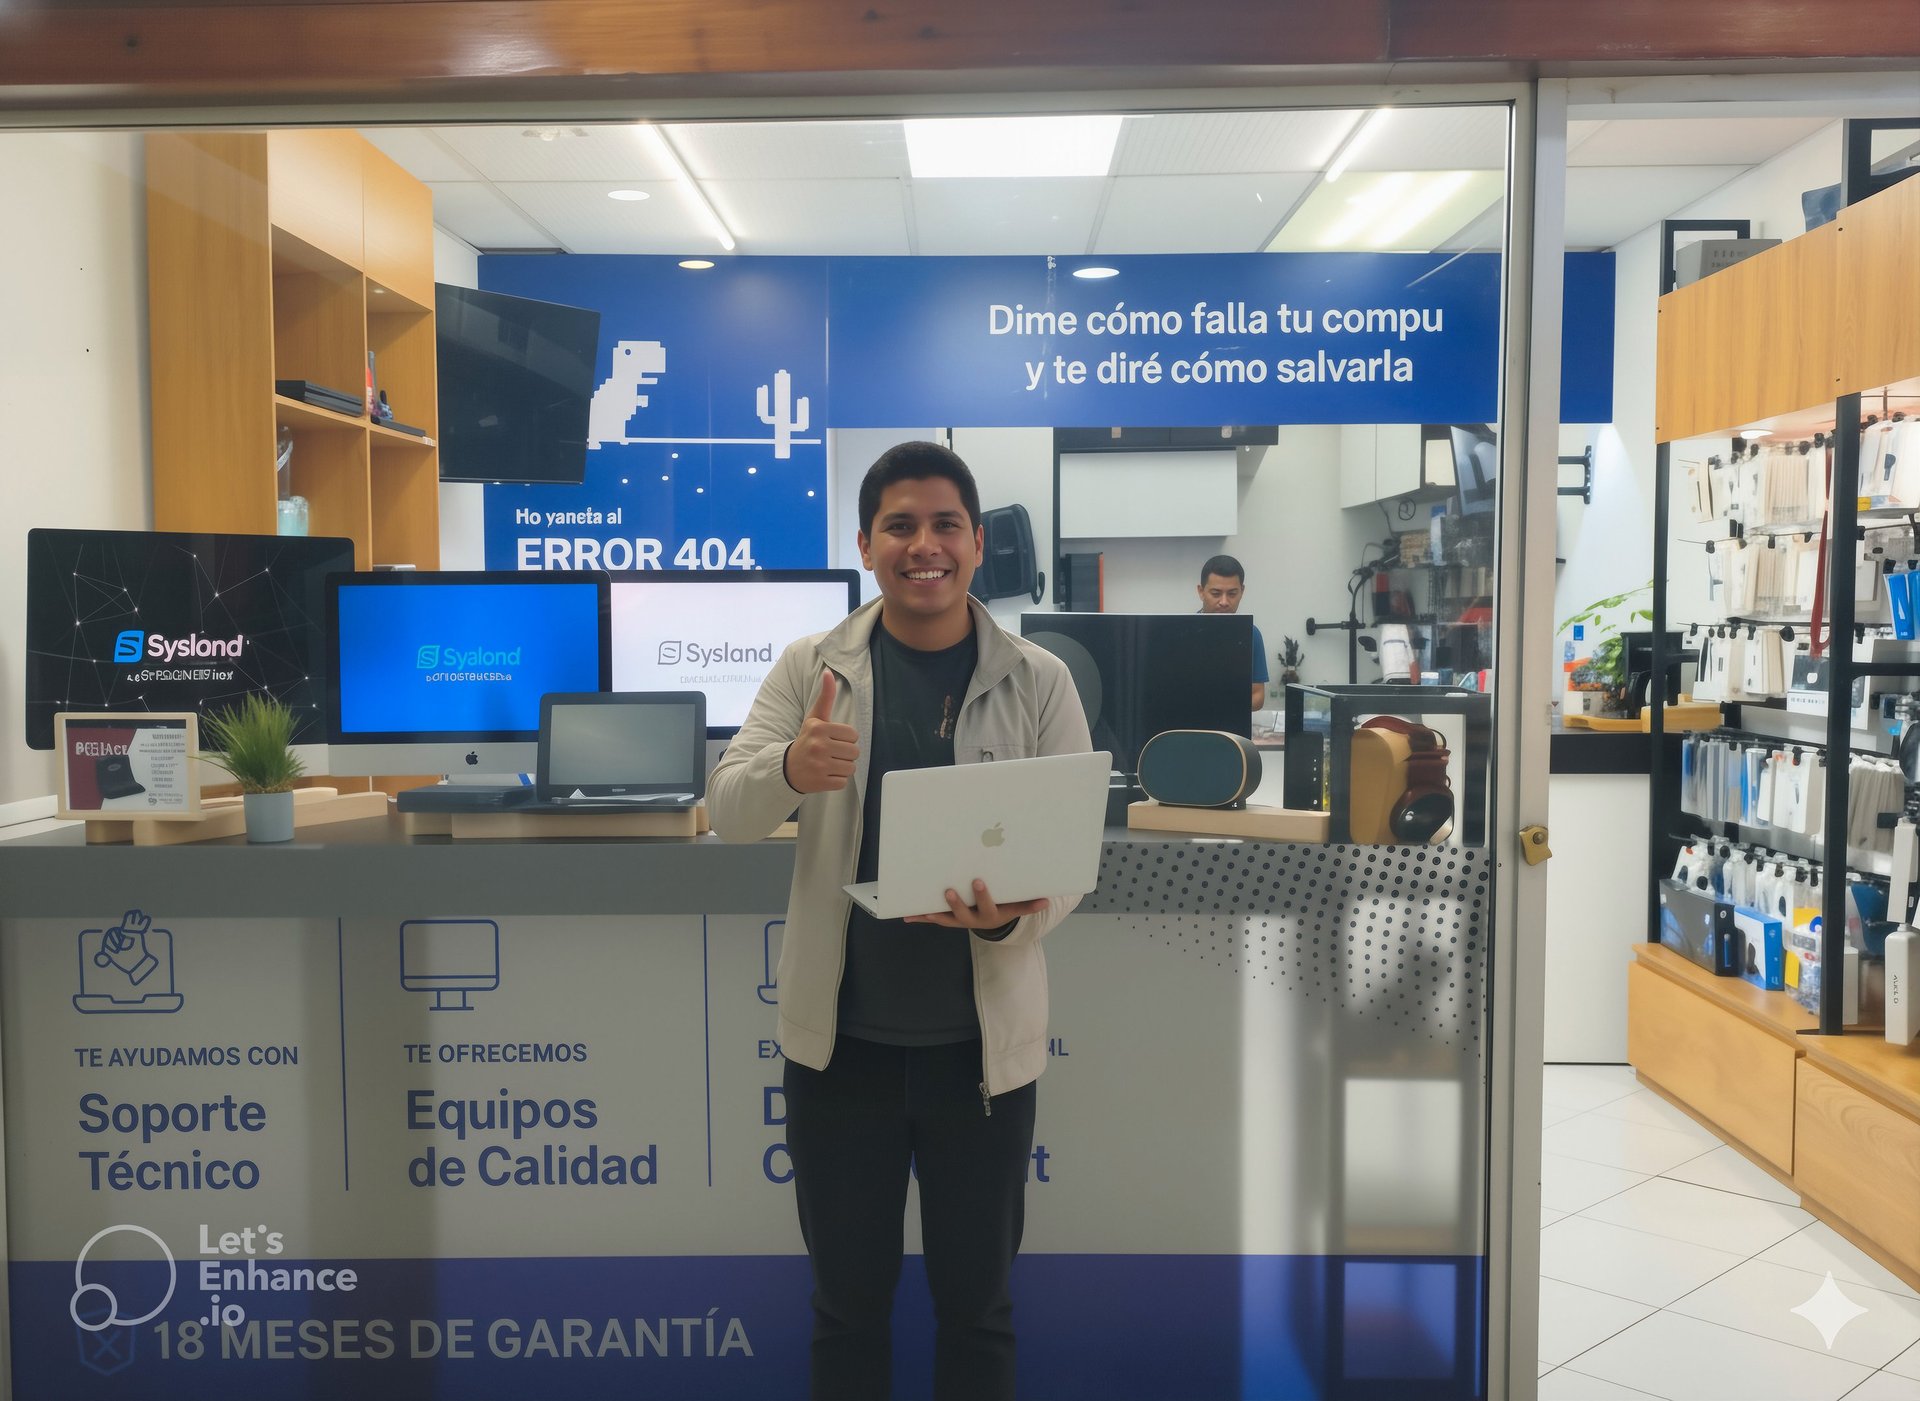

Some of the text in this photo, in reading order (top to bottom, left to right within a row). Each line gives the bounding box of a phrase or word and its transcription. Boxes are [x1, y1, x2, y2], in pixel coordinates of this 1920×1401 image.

[989, 301, 1443, 341] Dime cómo falla tu compu
[1025, 348, 1413, 391] y te diré cómo salvarla
[515, 507, 541, 525] Ho
[606, 507, 622, 525] al
[517, 537, 663, 570] ERROR
[686, 641, 772, 669] Sysland
[74, 1046, 299, 1067] TE AYUDAMOS CON
[403, 1042, 588, 1063] TE OFRECEMOS
[78, 1092, 267, 1144] Soporte
[407, 1087, 598, 1141] Equipos
[78, 1149, 260, 1191] Técnico
[408, 1144, 658, 1187] de Calidad
[153, 1306, 755, 1360] 18 MESES DE GARANTÍA
